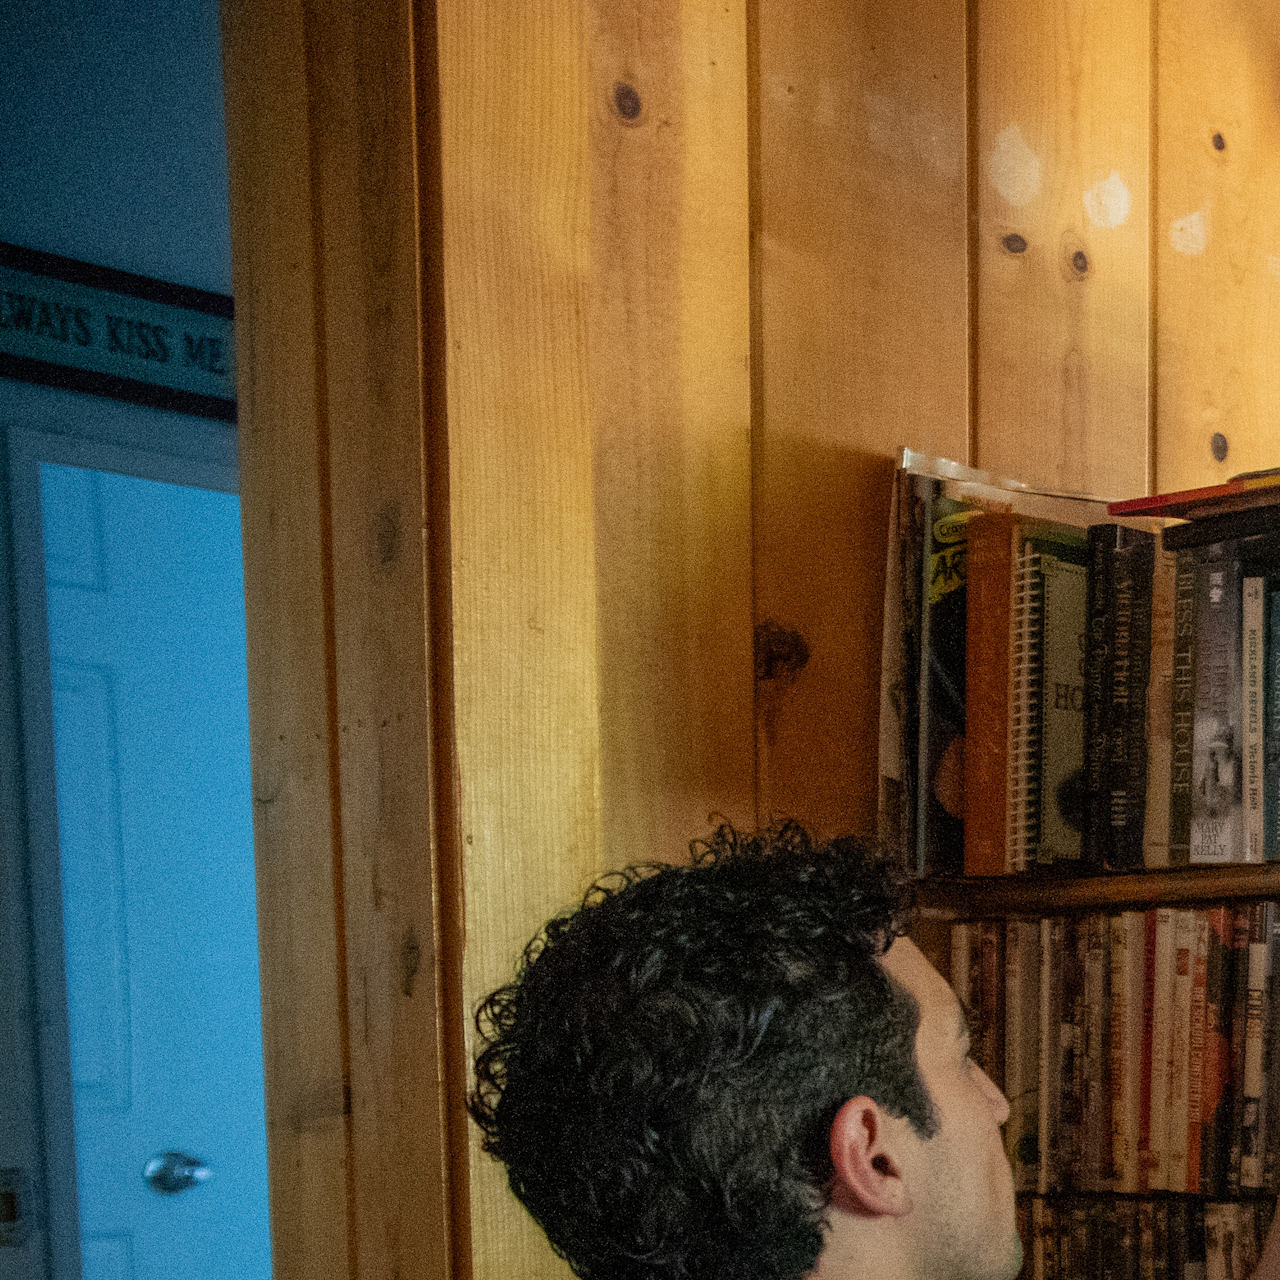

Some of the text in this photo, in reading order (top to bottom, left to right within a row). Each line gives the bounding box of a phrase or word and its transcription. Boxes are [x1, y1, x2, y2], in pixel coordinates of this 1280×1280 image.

[104, 313, 168, 364] KISS
[183, 331, 226, 376] ME
[1173, 572, 1194, 794] BLESS THIS HOUSE
[1248, 629, 1258, 688] KIRKLAND
[1248, 690, 1258, 734] REVELS
[1248, 743, 1259, 785] Victoria
